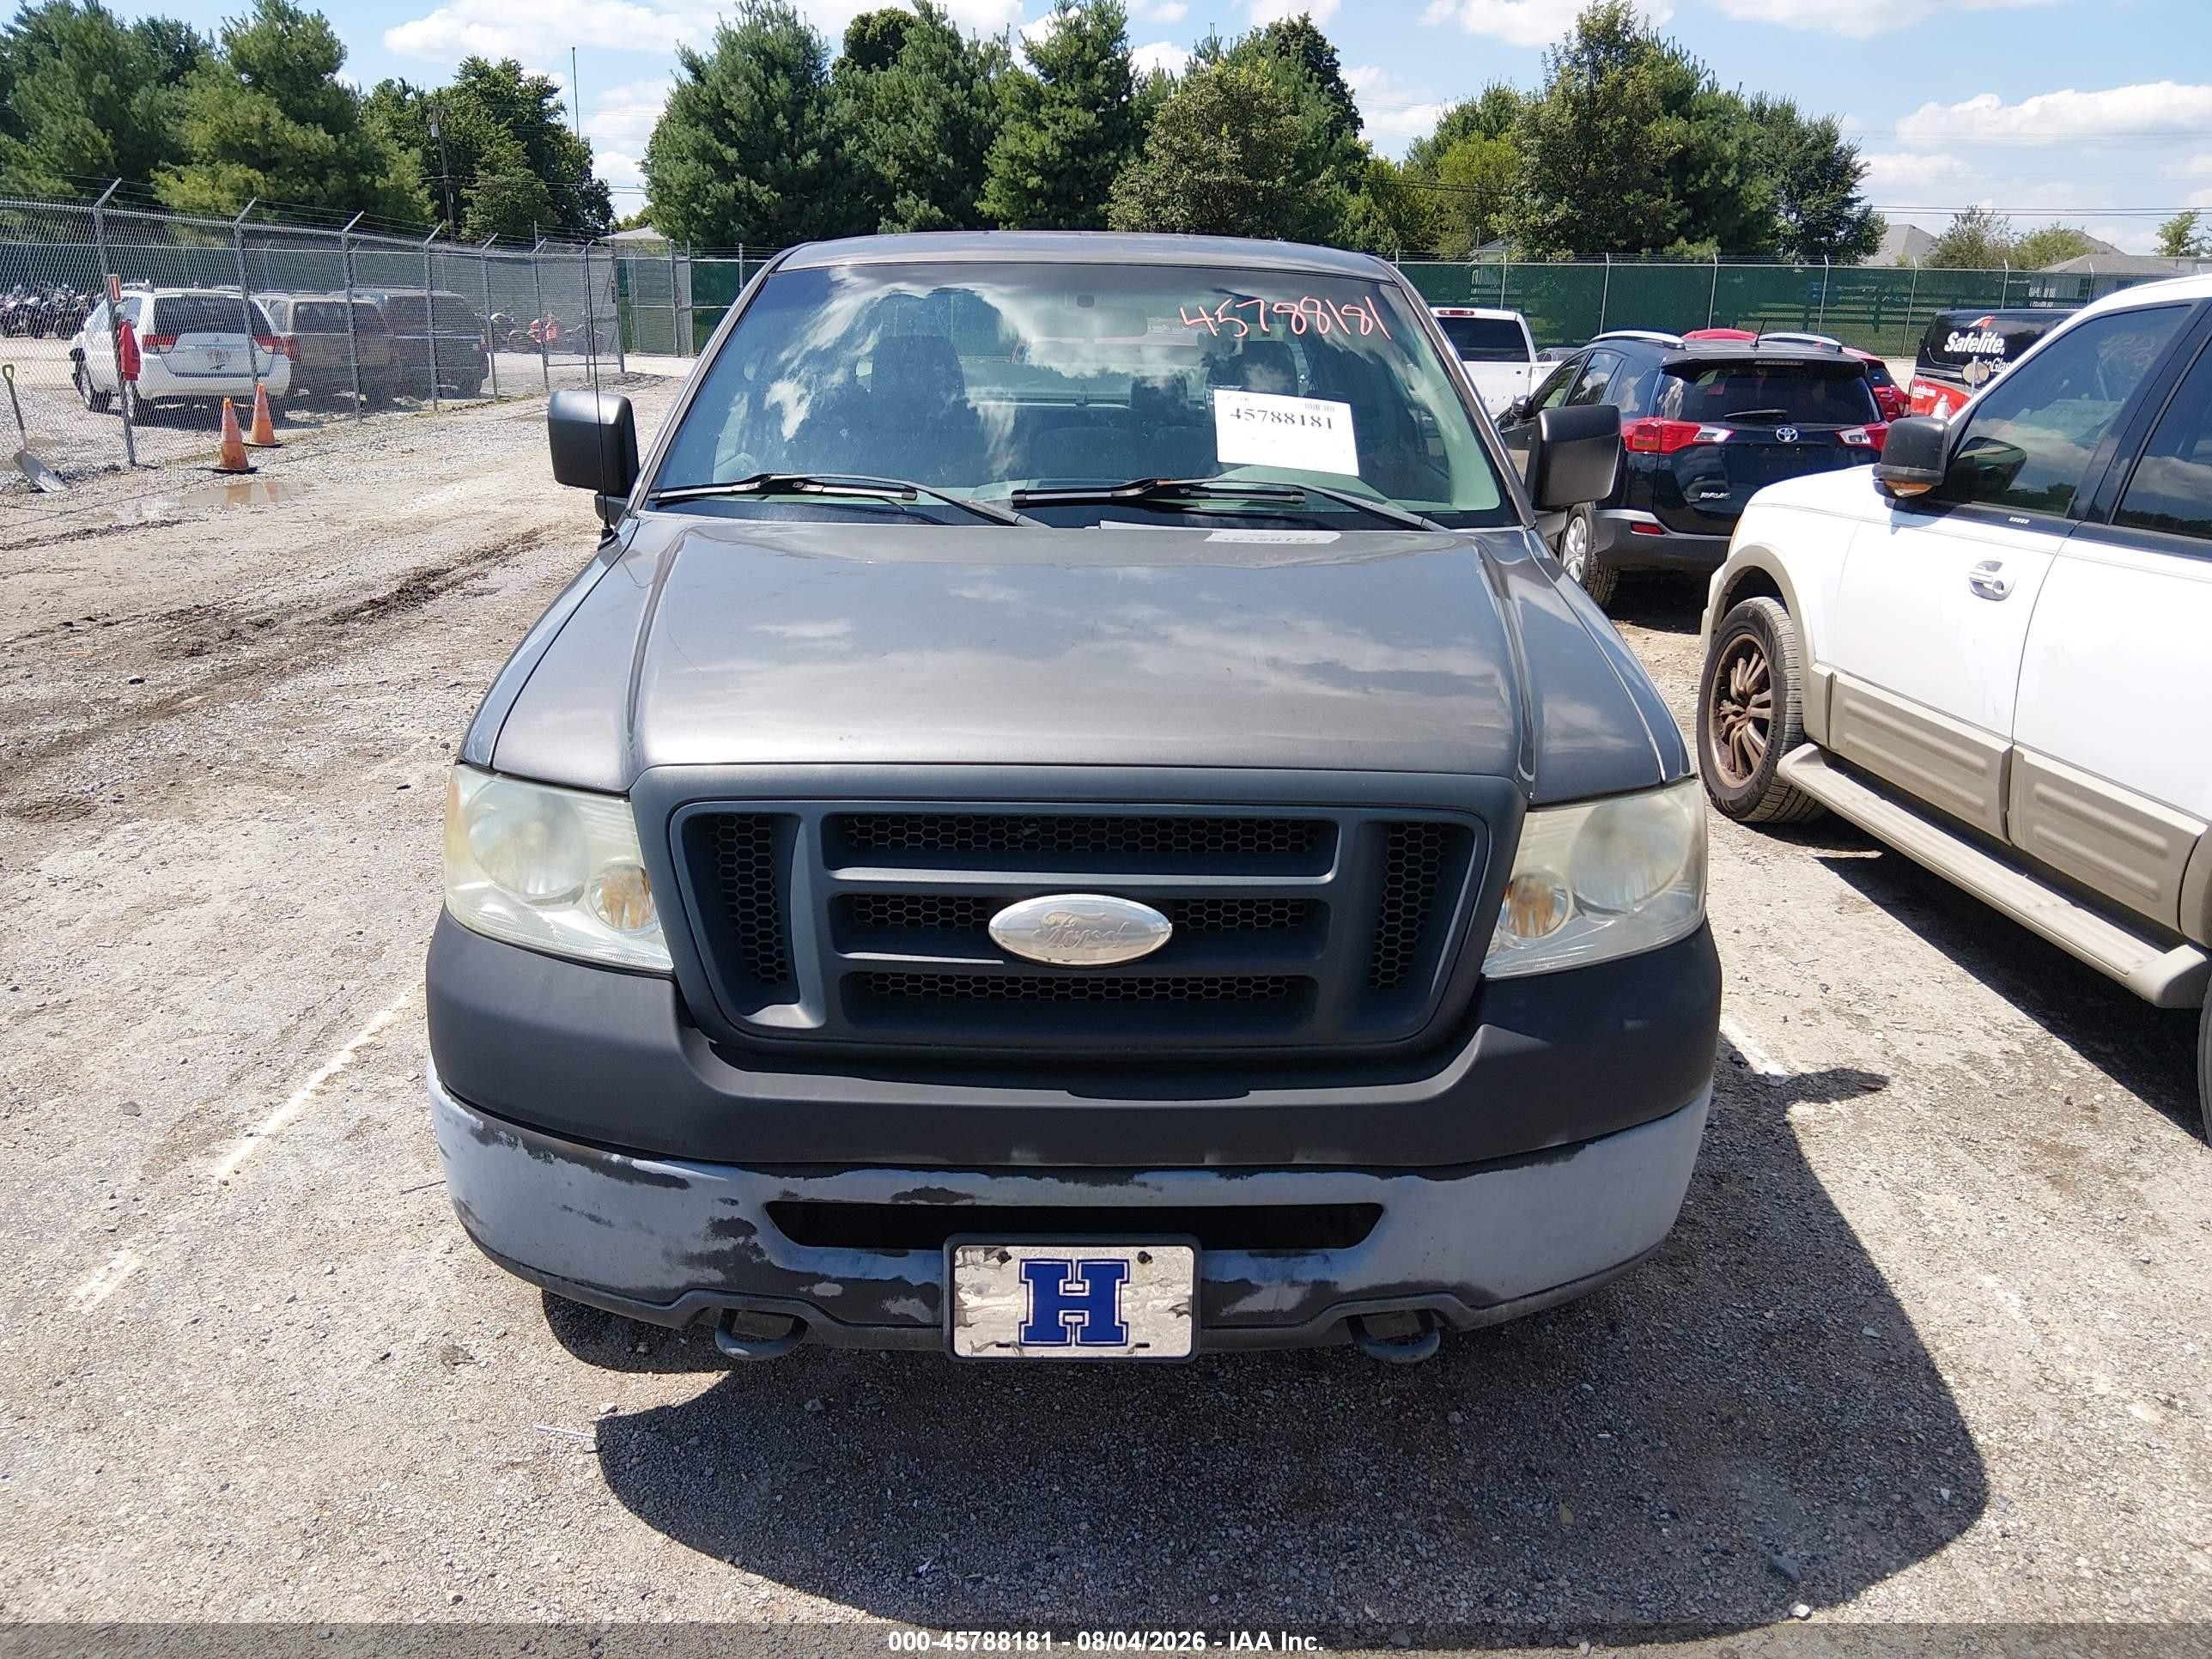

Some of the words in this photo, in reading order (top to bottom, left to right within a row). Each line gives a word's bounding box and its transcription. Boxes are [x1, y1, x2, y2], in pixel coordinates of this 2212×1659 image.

[1180, 295, 1391, 340] 45788181
[1230, 407, 1333, 429] 45788181
[1031, 909, 1129, 949] Ford
[1018, 1258, 1130, 1346] H
